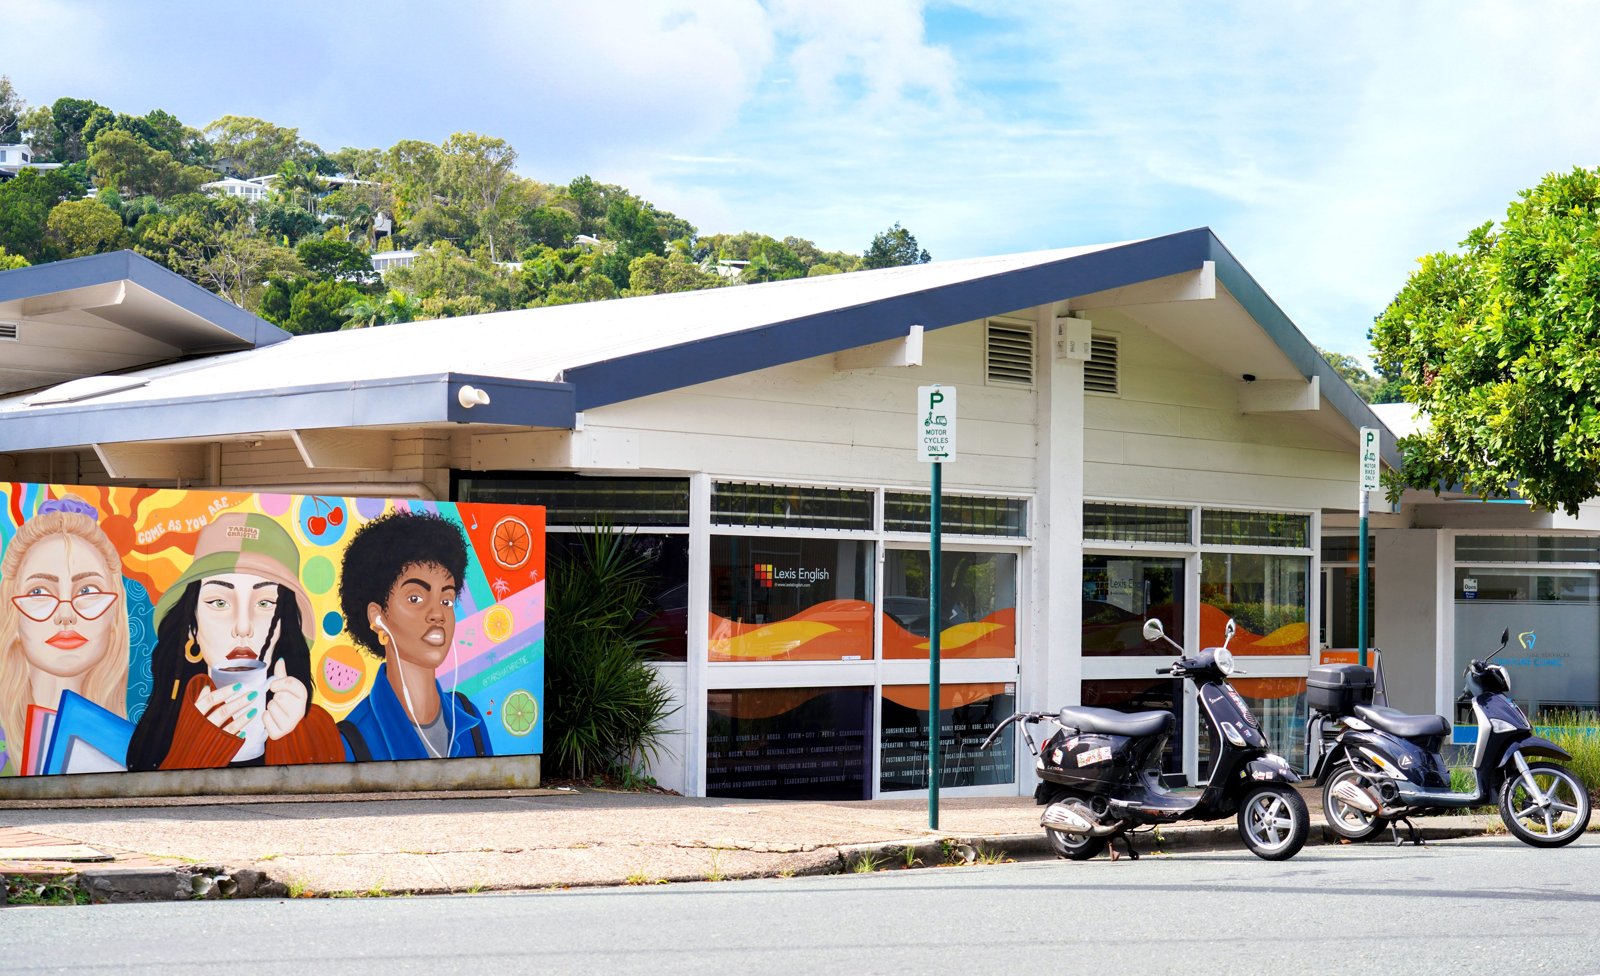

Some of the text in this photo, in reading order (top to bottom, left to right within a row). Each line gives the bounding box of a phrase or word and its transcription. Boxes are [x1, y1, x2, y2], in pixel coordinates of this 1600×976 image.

[930, 392, 944, 410] P
[1366, 432, 1375, 447] P
[137, 522, 166, 545] COME
[167, 519, 182, 532] AS
[185, 514, 208, 532] YOU
[228, 526, 258, 535] TARSHA
[774, 567, 830, 583] Lexis English
